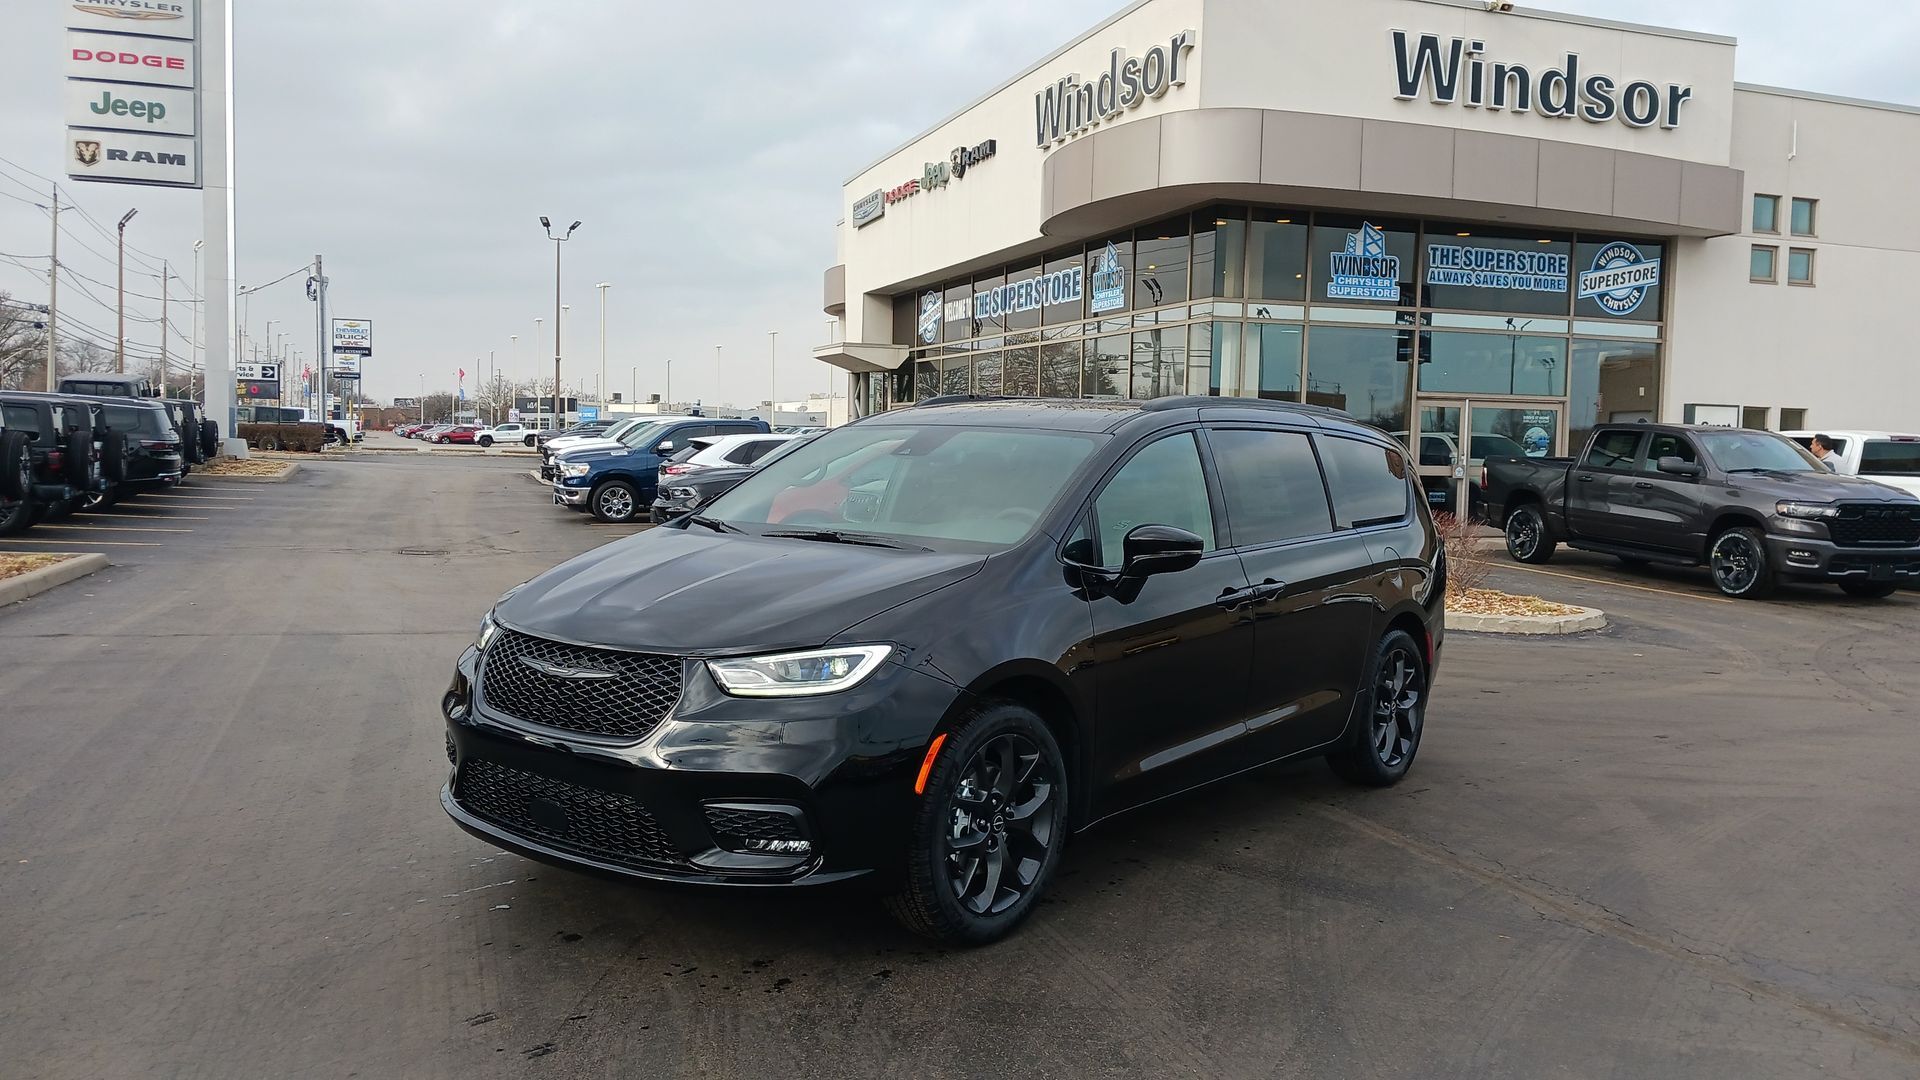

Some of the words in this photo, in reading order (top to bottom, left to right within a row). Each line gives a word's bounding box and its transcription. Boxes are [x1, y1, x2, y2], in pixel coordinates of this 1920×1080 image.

[73, 49, 185, 70] DODGE
[1034, 29, 1195, 149] Windsor
[1388, 28, 1692, 130] Windsor
[90, 91, 166, 123] Jeep
[107, 149, 186, 166] RAM
[962, 139, 996, 167] RAM
[921, 162, 950, 191] Jeep
[853, 193, 879, 212] CHRYSLER
[886, 179, 920, 205] DODGE
[1333, 255, 1396, 278] WINDSOR
[1430, 247, 1460, 266] THE
[1463, 249, 1567, 274] SUPERSTORE
[1598, 247, 1636, 267] WINDSOR
[1337, 277, 1391, 287] CHRYSLER
[1429, 270, 1472, 283] ALWAYS
[1475, 272, 1509, 287] SAVES
[1512, 275, 1531, 288] YOU
[1533, 276, 1566, 291] MORE!
[1582, 266, 1657, 292] SUPERSTORE
[975, 293, 989, 317] THE
[992, 269, 1081, 315] SUPERSTORE
[1330, 286, 1397, 298] SUPERSTORE
[1603, 289, 1641, 311] CHRYSLER
